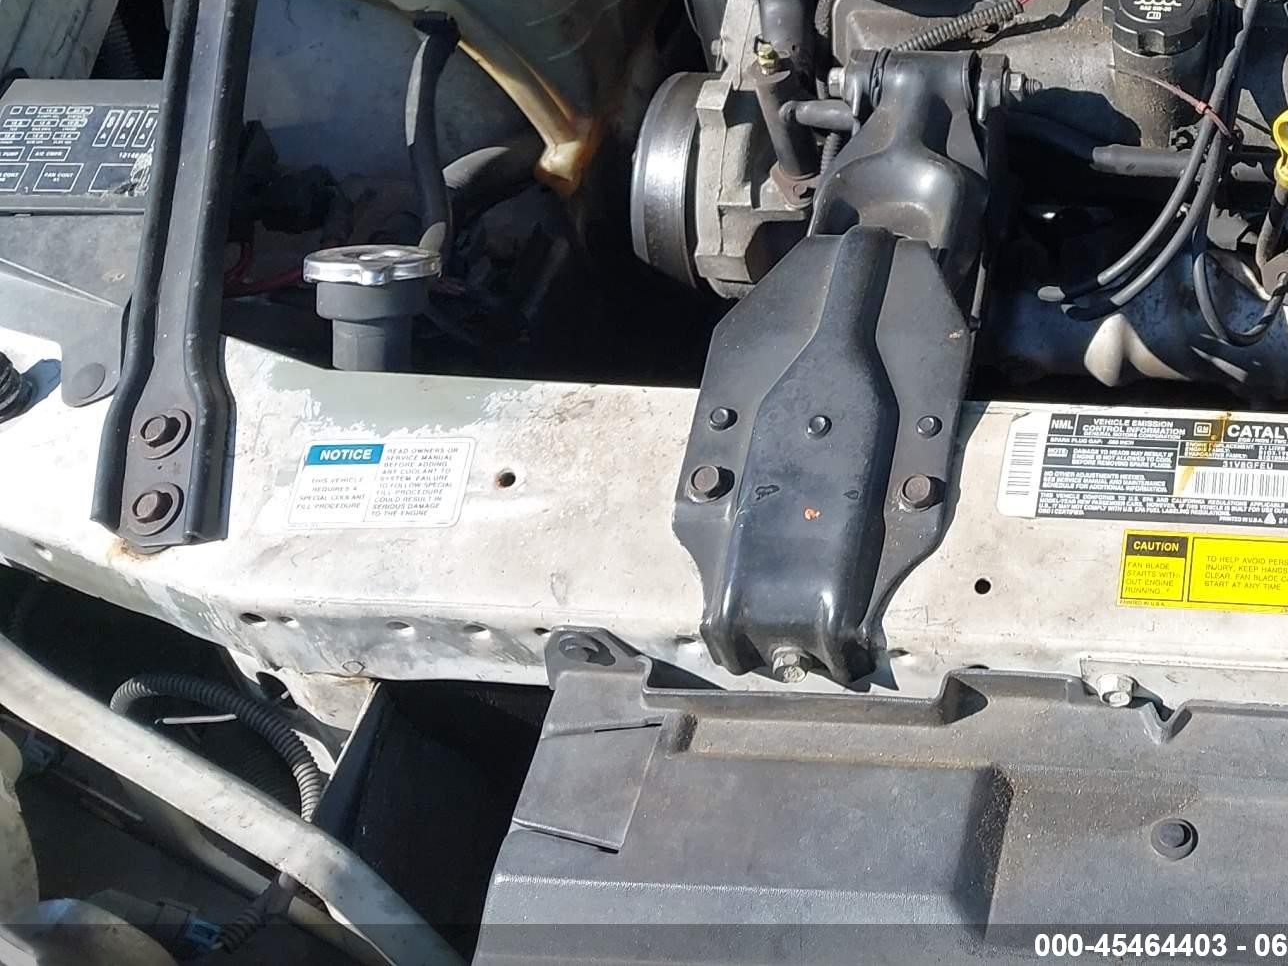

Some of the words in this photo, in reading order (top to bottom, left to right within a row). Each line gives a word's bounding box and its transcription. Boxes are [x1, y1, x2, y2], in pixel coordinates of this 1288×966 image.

[1051, 419, 1074, 430] NML
[1093, 418, 1130, 426] VEHICLE
[1132, 420, 1174, 428] EMISSION
[1082, 425, 1126, 433] CONTROL
[1126, 427, 1186, 436] INFORMATION
[319, 449, 373, 461] NOTICE
[1133, 541, 1180, 551] CAUTION
[1207, 555, 1217, 563] TO
[1219, 556, 1240, 564] HELP
[1242, 557, 1266, 565] AVOID
[1238, 565, 1260, 573] KEEP
[1235, 573, 1251, 581] FAN
[1253, 574, 1279, 582] BLADE
[1144, 579, 1175, 587] ENGINE
[1243, 582, 1261, 590] ANY
